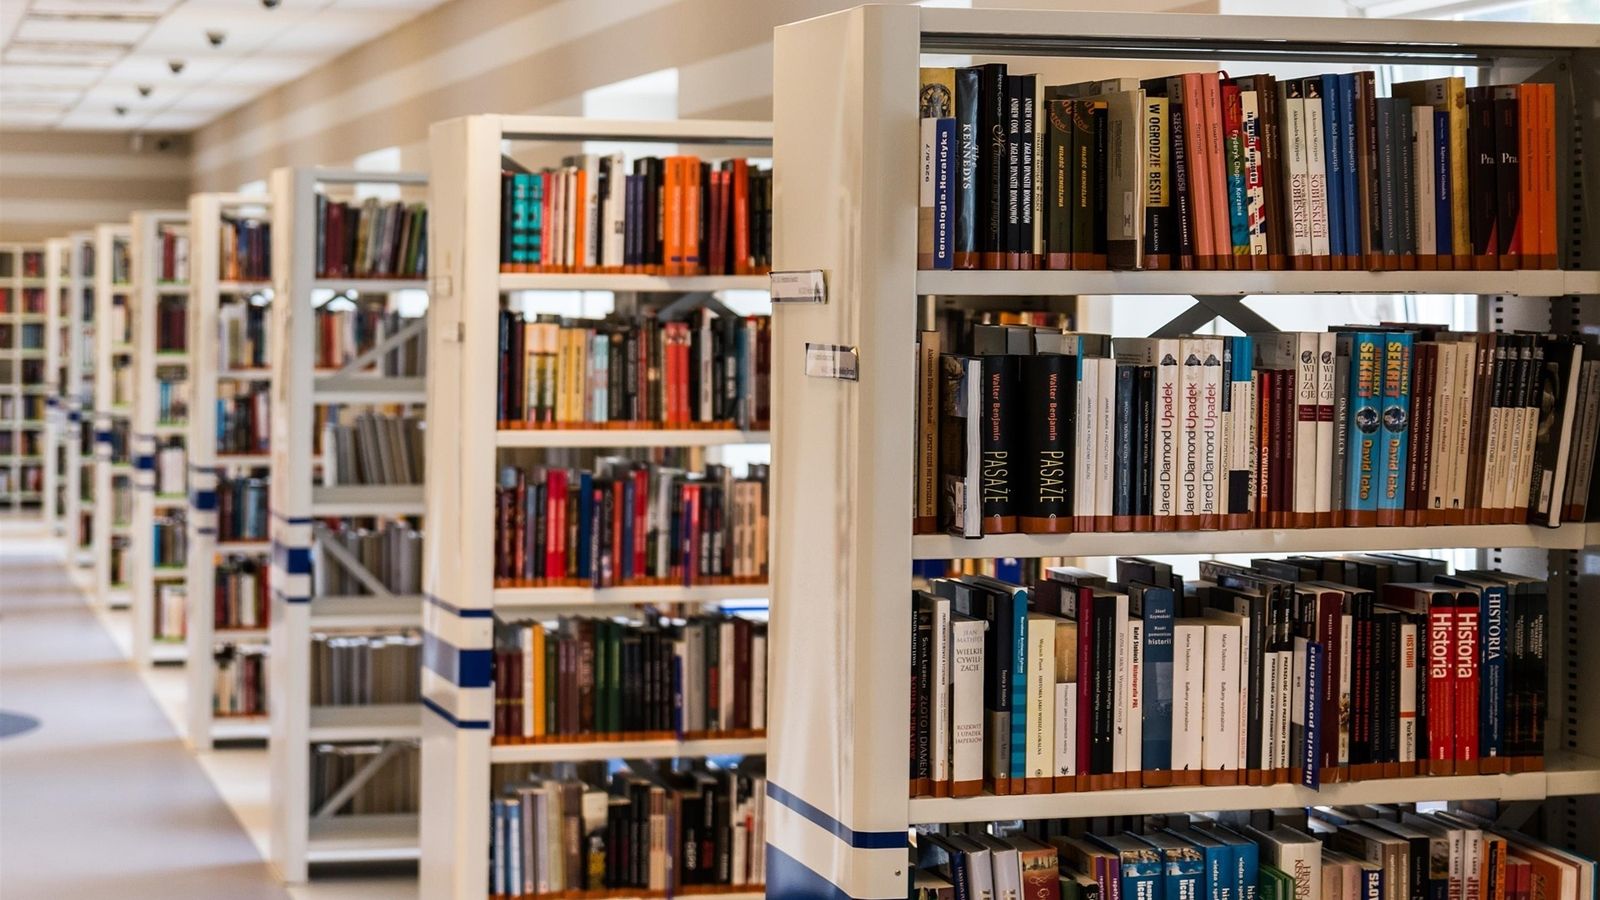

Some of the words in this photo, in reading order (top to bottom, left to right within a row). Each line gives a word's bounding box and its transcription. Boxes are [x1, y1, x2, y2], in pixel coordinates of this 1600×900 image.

[1010, 98, 1019, 118] ANDREW
[1024, 98, 1032, 118] ANDREW
[1149, 104, 1161, 114] W
[1010, 120, 1019, 134] COOK
[1024, 120, 1032, 134] COOK
[1149, 117, 1161, 168] OGRODZIE
[963, 124, 971, 189] KENNEDYS
[1232, 130, 1240, 160] Fryderyk
[938, 131, 949, 258] Genealogia.Heraldyka
[1150, 172, 1162, 204] BESTII
[1292, 174, 1304, 238] SOBIESKICH
[1311, 174, 1322, 238] SOBIESKICH
[992, 374, 1000, 399] Walter
[1049, 374, 1057, 399] Walter
[1303, 382, 1314, 390] ZA
[1323, 382, 1333, 390] ZA
[1359, 342, 1373, 398] SEKRET
[1386, 342, 1401, 398] SEKRET
[1161, 382, 1174, 428] Upadek
[1185, 382, 1199, 428] Upadek
[1204, 382, 1217, 428] Upadek
[1301, 391, 1316, 399] CJE
[1321, 391, 1334, 399] CJE
[991, 403, 1001, 441] Benjamin
[1048, 403, 1057, 441] Benjamin
[1159, 430, 1171, 482] Diamond
[1184, 430, 1196, 482] Diamond
[1203, 430, 1214, 482] Diamond
[1362, 440, 1372, 470] David
[1388, 439, 1400, 469] David
[984, 451, 1011, 503] PASAŻE
[1040, 451, 1066, 503] PASAŻE
[1360, 475, 1371, 500] Icke
[1387, 474, 1399, 498] Icke
[1159, 484, 1170, 516] Jared
[1184, 484, 1195, 515] Jared
[1203, 484, 1213, 514] Jared
[1488, 593, 1501, 660] HISTORIA
[1406, 634, 1414, 668] HISTORIA
[1432, 613, 1452, 678] Historia
[1457, 613, 1478, 678] Historia
[960, 664, 979, 672] ZACJE
[1131, 664, 1139, 697] Historiografia
[1307, 646, 1315, 728] powszechna
[921, 695, 929, 727] ZŁOTO
[1306, 732, 1314, 784] Historia
[1302, 866, 1311, 897] HENRY
